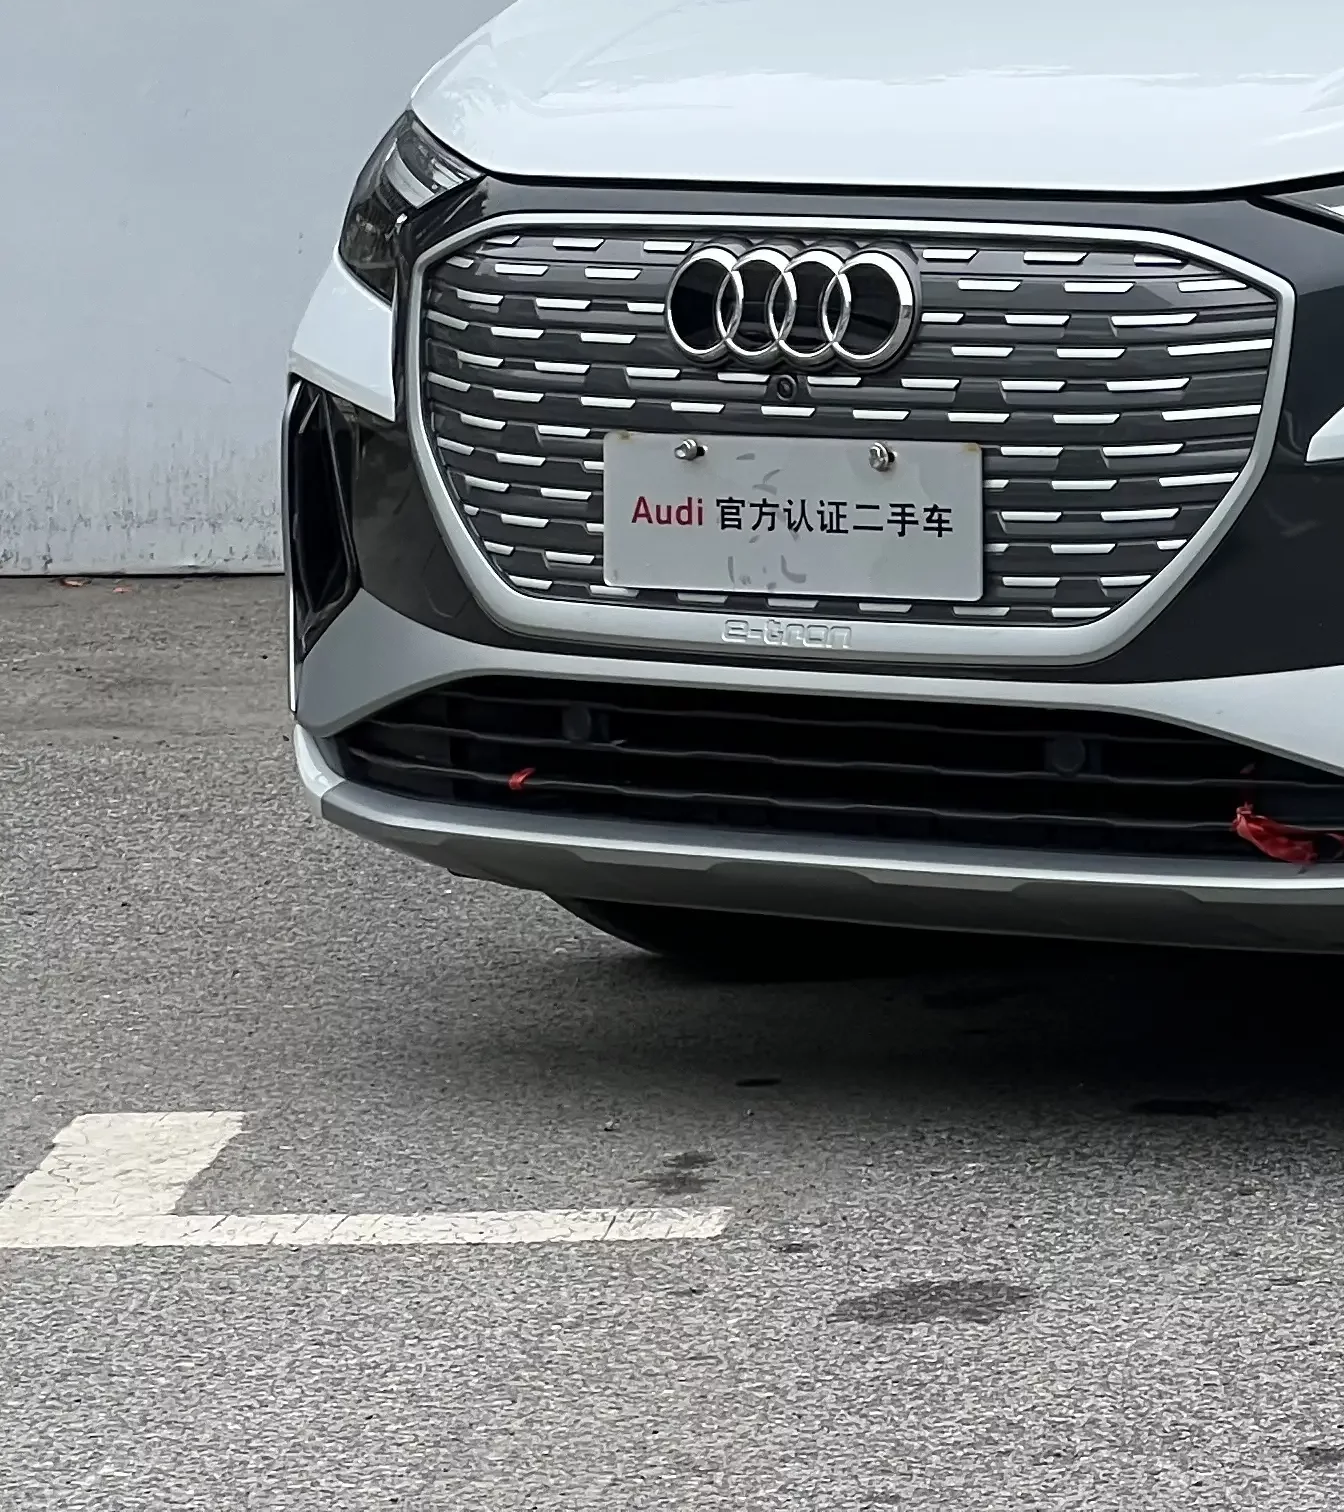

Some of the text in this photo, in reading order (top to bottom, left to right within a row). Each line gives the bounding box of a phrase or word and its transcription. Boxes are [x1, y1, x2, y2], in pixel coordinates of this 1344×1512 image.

[631, 495, 953, 538] Audi 官方认证二手车
[720, 618, 852, 650] e-tron
